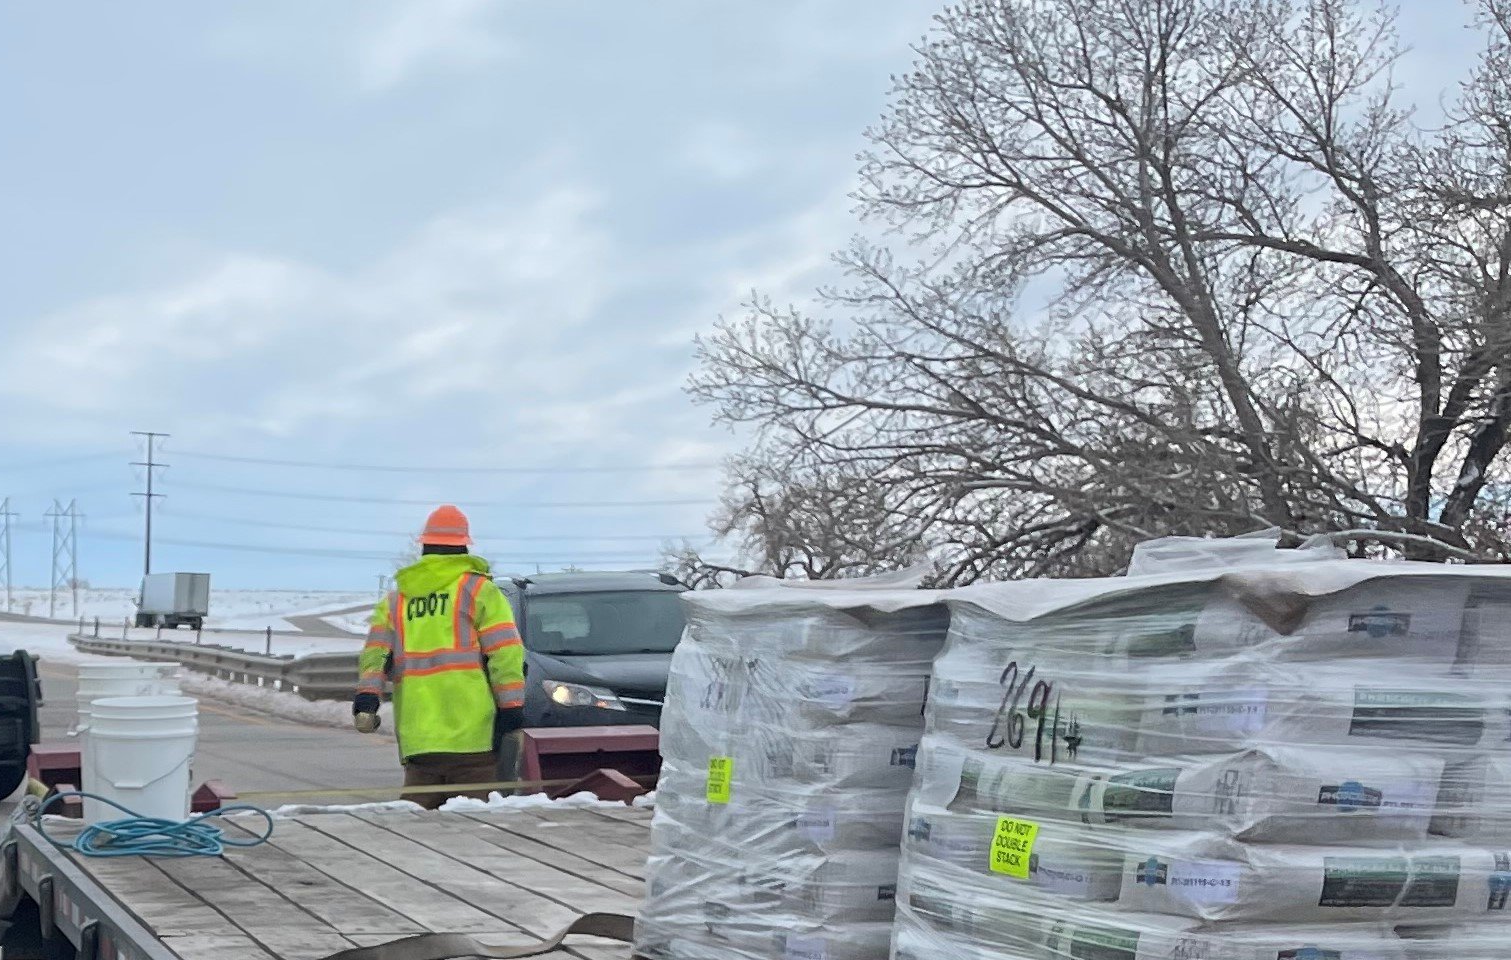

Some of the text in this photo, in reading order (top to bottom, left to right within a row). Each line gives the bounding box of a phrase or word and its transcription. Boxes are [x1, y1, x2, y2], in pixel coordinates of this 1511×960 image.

[407, 593, 449, 621] CDOT
[1000, 819, 1033, 836] DO NOT
[996, 834, 1029, 853] DOUBLE
[996, 850, 1021, 867] STACK
